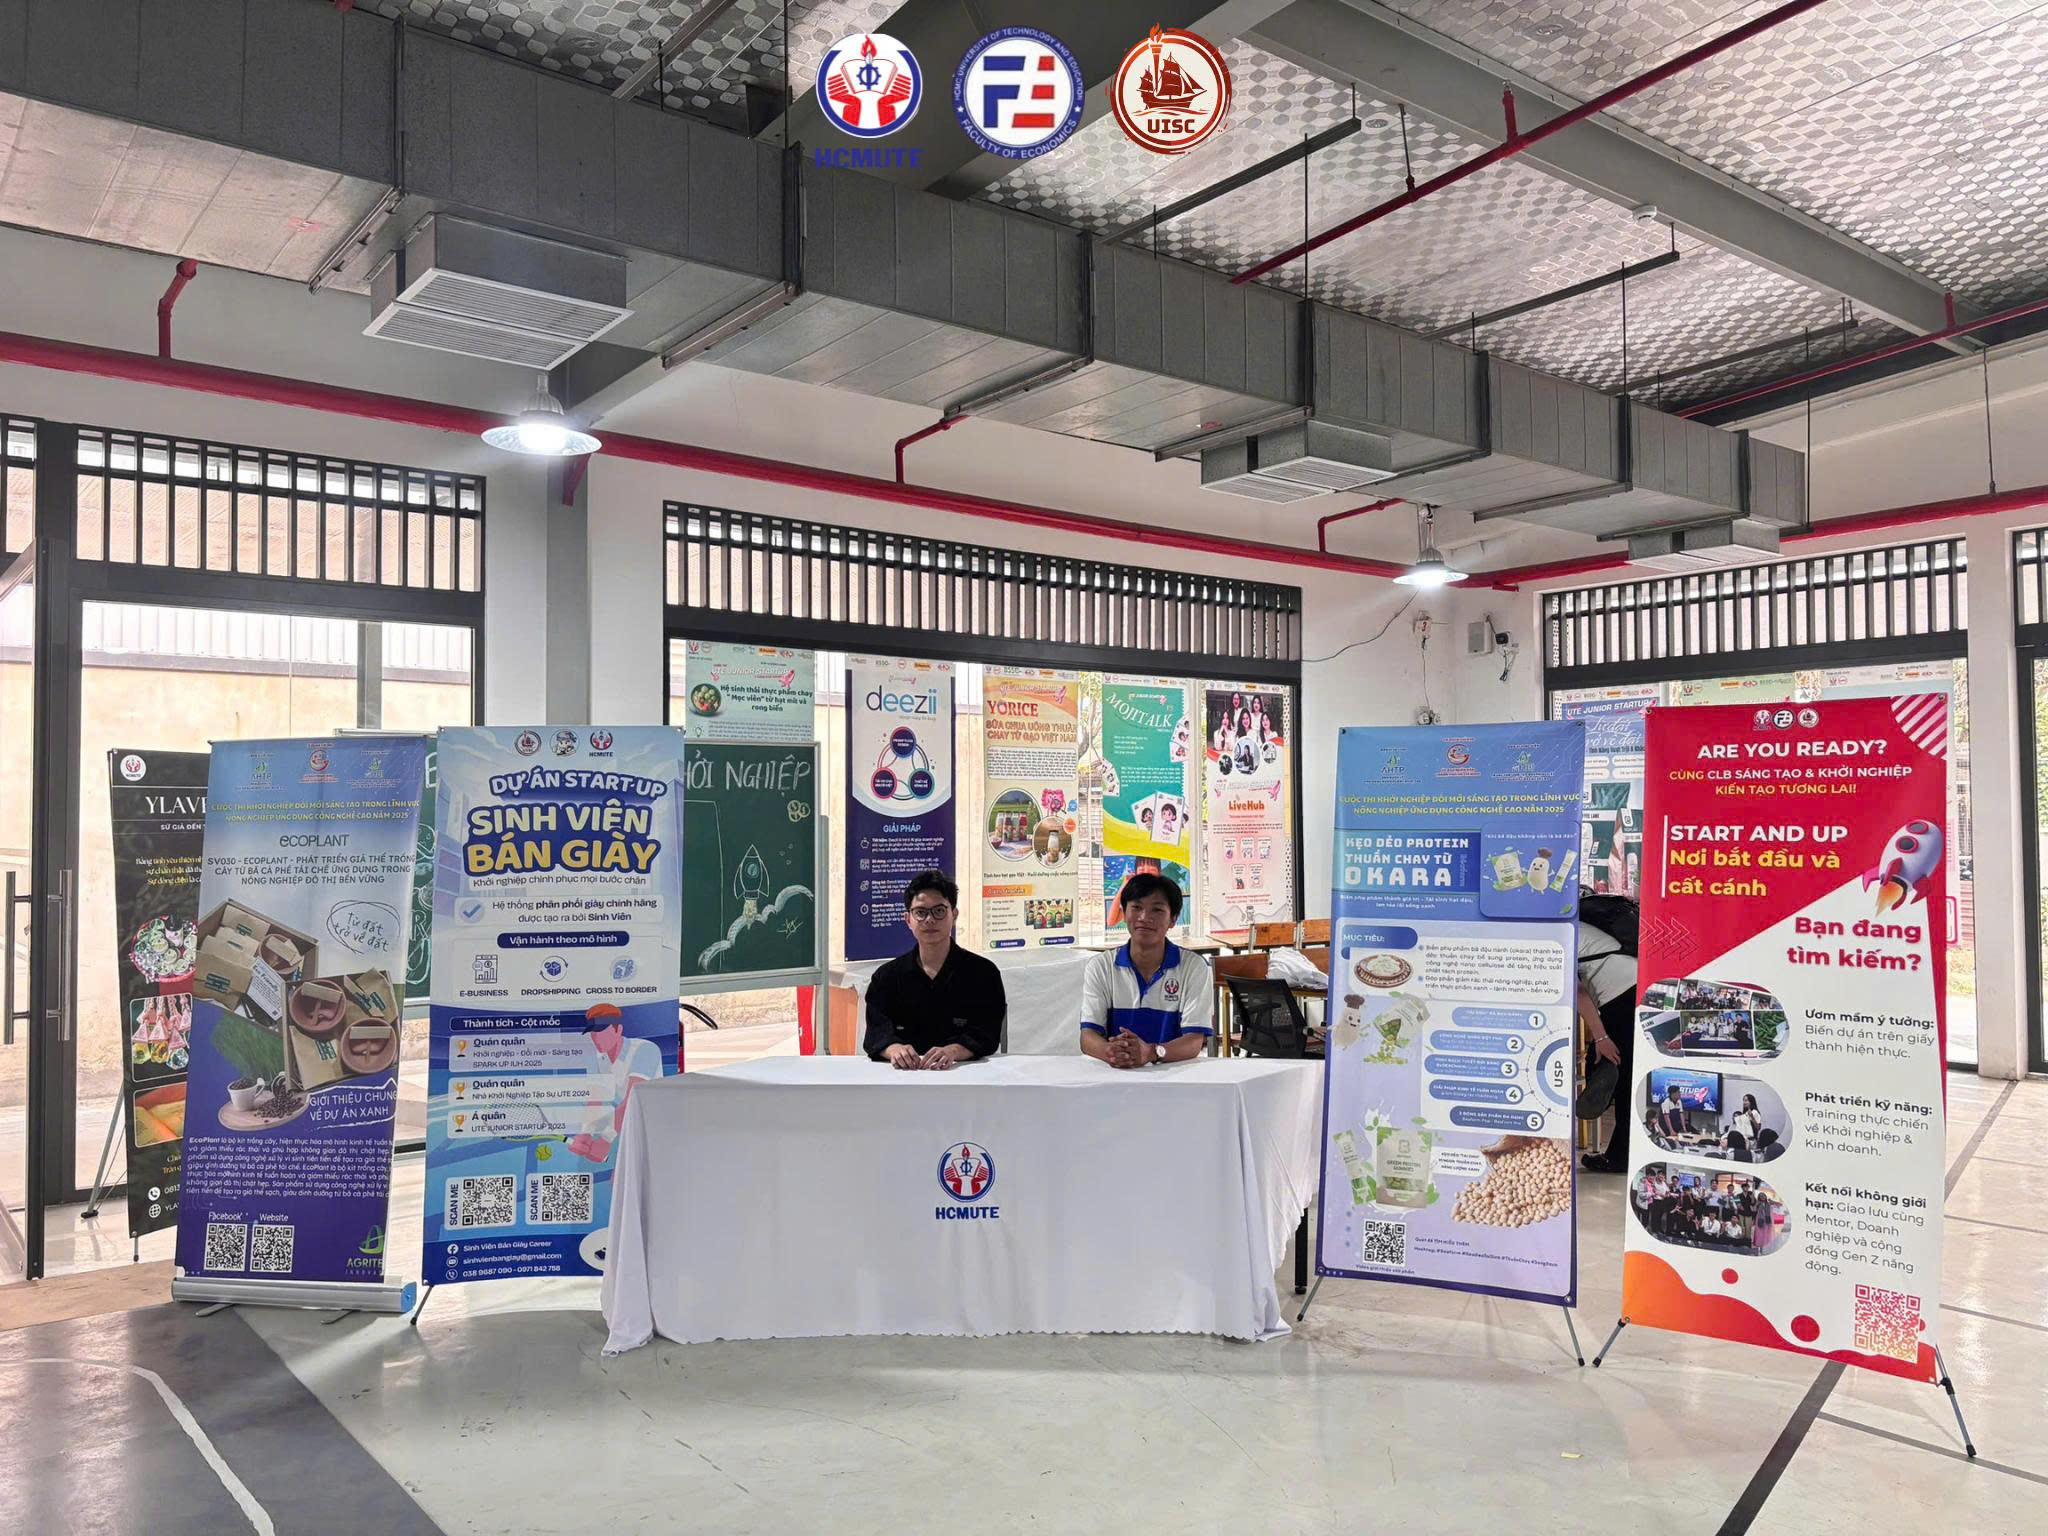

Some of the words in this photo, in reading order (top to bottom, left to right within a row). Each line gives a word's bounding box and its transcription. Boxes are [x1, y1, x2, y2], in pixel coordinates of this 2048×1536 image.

[866, 685, 937, 714] deezii
[988, 700, 1039, 717] YORICE
[1106, 692, 1172, 728] MOJITALK
[1697, 744, 1739, 758] ARE
[1744, 743, 1790, 757] YOU
[1797, 739, 1887, 756] READY?
[684, 750, 714, 790] HỞI
[726, 754, 810, 797] NGHIỆP
[1669, 769, 1704, 780] CÙNG
[1707, 770, 1731, 780] CLB
[1735, 767, 1770, 779] SÁNG
[1774, 769, 1801, 780] TẠO
[1805, 769, 1814, 778] &
[1818, 765, 1853, 778] KHỞI
[1857, 764, 1912, 779] NGHIỆP
[492, 771, 527, 795] DỰ
[530, 768, 559, 788] ÁN
[565, 772, 665, 798] START-UP
[1715, 782, 1745, 795] KIẾN
[1749, 785, 1775, 796] TẠO
[1779, 784, 1827, 794] TƯƠNG
[1831, 784, 1857, 793] LAI!
[1229, 800, 1264, 810] LiveHub
[471, 806, 556, 836] SINH
[565, 799, 648, 834] VIÊN
[883, 822, 898, 832] GIẢI
[900, 823, 921, 832] PHÁP
[1346, 838, 1372, 849] KẸO
[1376, 835, 1402, 848] DẺO
[1407, 838, 1468, 848] PROTEIN
[1671, 825, 1744, 841] START
[1749, 825, 1804, 841] AND
[1812, 825, 1847, 842] UP
[468, 832, 549, 873] BÁN
[562, 831, 656, 871] GIÀY
[1671, 849, 1706, 865] Nơi
[1714, 848, 1751, 866] bắt
[1758, 848, 1803, 868] đầu
[1812, 852, 1840, 868] và
[1344, 866, 1451, 886] OKARA
[1669, 876, 1703, 894] cất
[1710, 878, 1767, 896] cánh
[1364, 933, 1384, 943] TIÊU:
[1795, 917, 1844, 939] Bạn
[1852, 920, 1921, 943] đang
[1787, 946, 1830, 965] tìm
[1839, 949, 1921, 970] kiếm?
[521, 988, 581, 996] DROPSHIPPING
[625, 986, 657, 994] BORDER
[464, 1019, 493, 1028] Thành
[496, 1019, 513, 1027] tích
[521, 1019, 537, 1028] Cột
[539, 1016, 560, 1026] mốc
[1533, 1016, 1538, 1025] 1
[1806, 1008, 1835, 1020] Ươm
[1840, 1012, 1874, 1023] mầm
[1877, 1015, 1885, 1026] ý
[1889, 1016, 1934, 1029] tưởng:
[1511, 1040, 1518, 1049] 2
[1805, 1024, 1833, 1036] Biến
[1837, 1027, 1854, 1039] dự
[1858, 1030, 1873, 1039] án
[1877, 1031, 1903, 1042] trên
[1907, 1033, 1934, 1046] giấy
[1805, 1040, 1842, 1052] thành
[1847, 1043, 1874, 1056] hiện
[1878, 1047, 1910, 1059] thực.
[1505, 1064, 1512, 1074] 3
[1555, 1060, 1563, 1088] USP
[310, 1094, 329, 1106] GIỚI
[332, 1092, 362, 1105] THIỆU
[365, 1091, 397, 1102] CHUNG
[1509, 1090, 1517, 1099] 4
[1806, 1092, 1836, 1104] Phát
[1840, 1096, 1871, 1107] triển
[1875, 1099, 1890, 1111] kỹ
[1894, 1102, 1932, 1115] năng:
[310, 1107, 321, 1120] VỀ
[325, 1110, 339, 1121] DỰ
[342, 1107, 357, 1119] ÁN
[360, 1106, 388, 1117] XANH
[1531, 1117, 1537, 1127] 5
[1806, 1107, 1856, 1123] Training
[1860, 1114, 1890, 1125] thực
[1893, 1118, 1928, 1130] chiến
[1805, 1123, 1819, 1133] về
[1823, 1125, 1851, 1137] Khởi
[1855, 1130, 1901, 1144] nghiệp
[1904, 1134, 1912, 1144] &
[1806, 1139, 1833, 1150] Kinh
[1838, 1142, 1881, 1156] doanh.
[450, 1184, 458, 1199] ME
[531, 1180, 538, 1195] ME
[1806, 1182, 1827, 1194] Kết
[1832, 1186, 1851, 1196] nối
[1856, 1189, 1898, 1205] không
[1902, 1196, 1926, 1208] giới
[208, 1212, 242, 1221] Facebook
[450, 1200, 458, 1225] SCAN
[530, 1196, 538, 1220] SCAN
[936, 1207, 1000, 1219] HCMUTE
[1806, 1198, 1833, 1210] hạn:
[1837, 1202, 1865, 1214] Giao
[1869, 1206, 1888, 1218] lưu
[1892, 1212, 1924, 1226] cùng
[259, 1214, 288, 1222] Website
[1806, 1214, 1853, 1230] Mentor,
[1857, 1221, 1899, 1236] Doanh
[1806, 1230, 1850, 1245] nghiệp
[1853, 1237, 1867, 1246] và
[1871, 1240, 1901, 1255] cộng
[1805, 1245, 1838, 1260] đồng
[1842, 1251, 1867, 1262] Gen
[1871, 1255, 1879, 1265] Z
[1883, 1258, 1914, 1273] năng
[1805, 1261, 1841, 1276] động.
